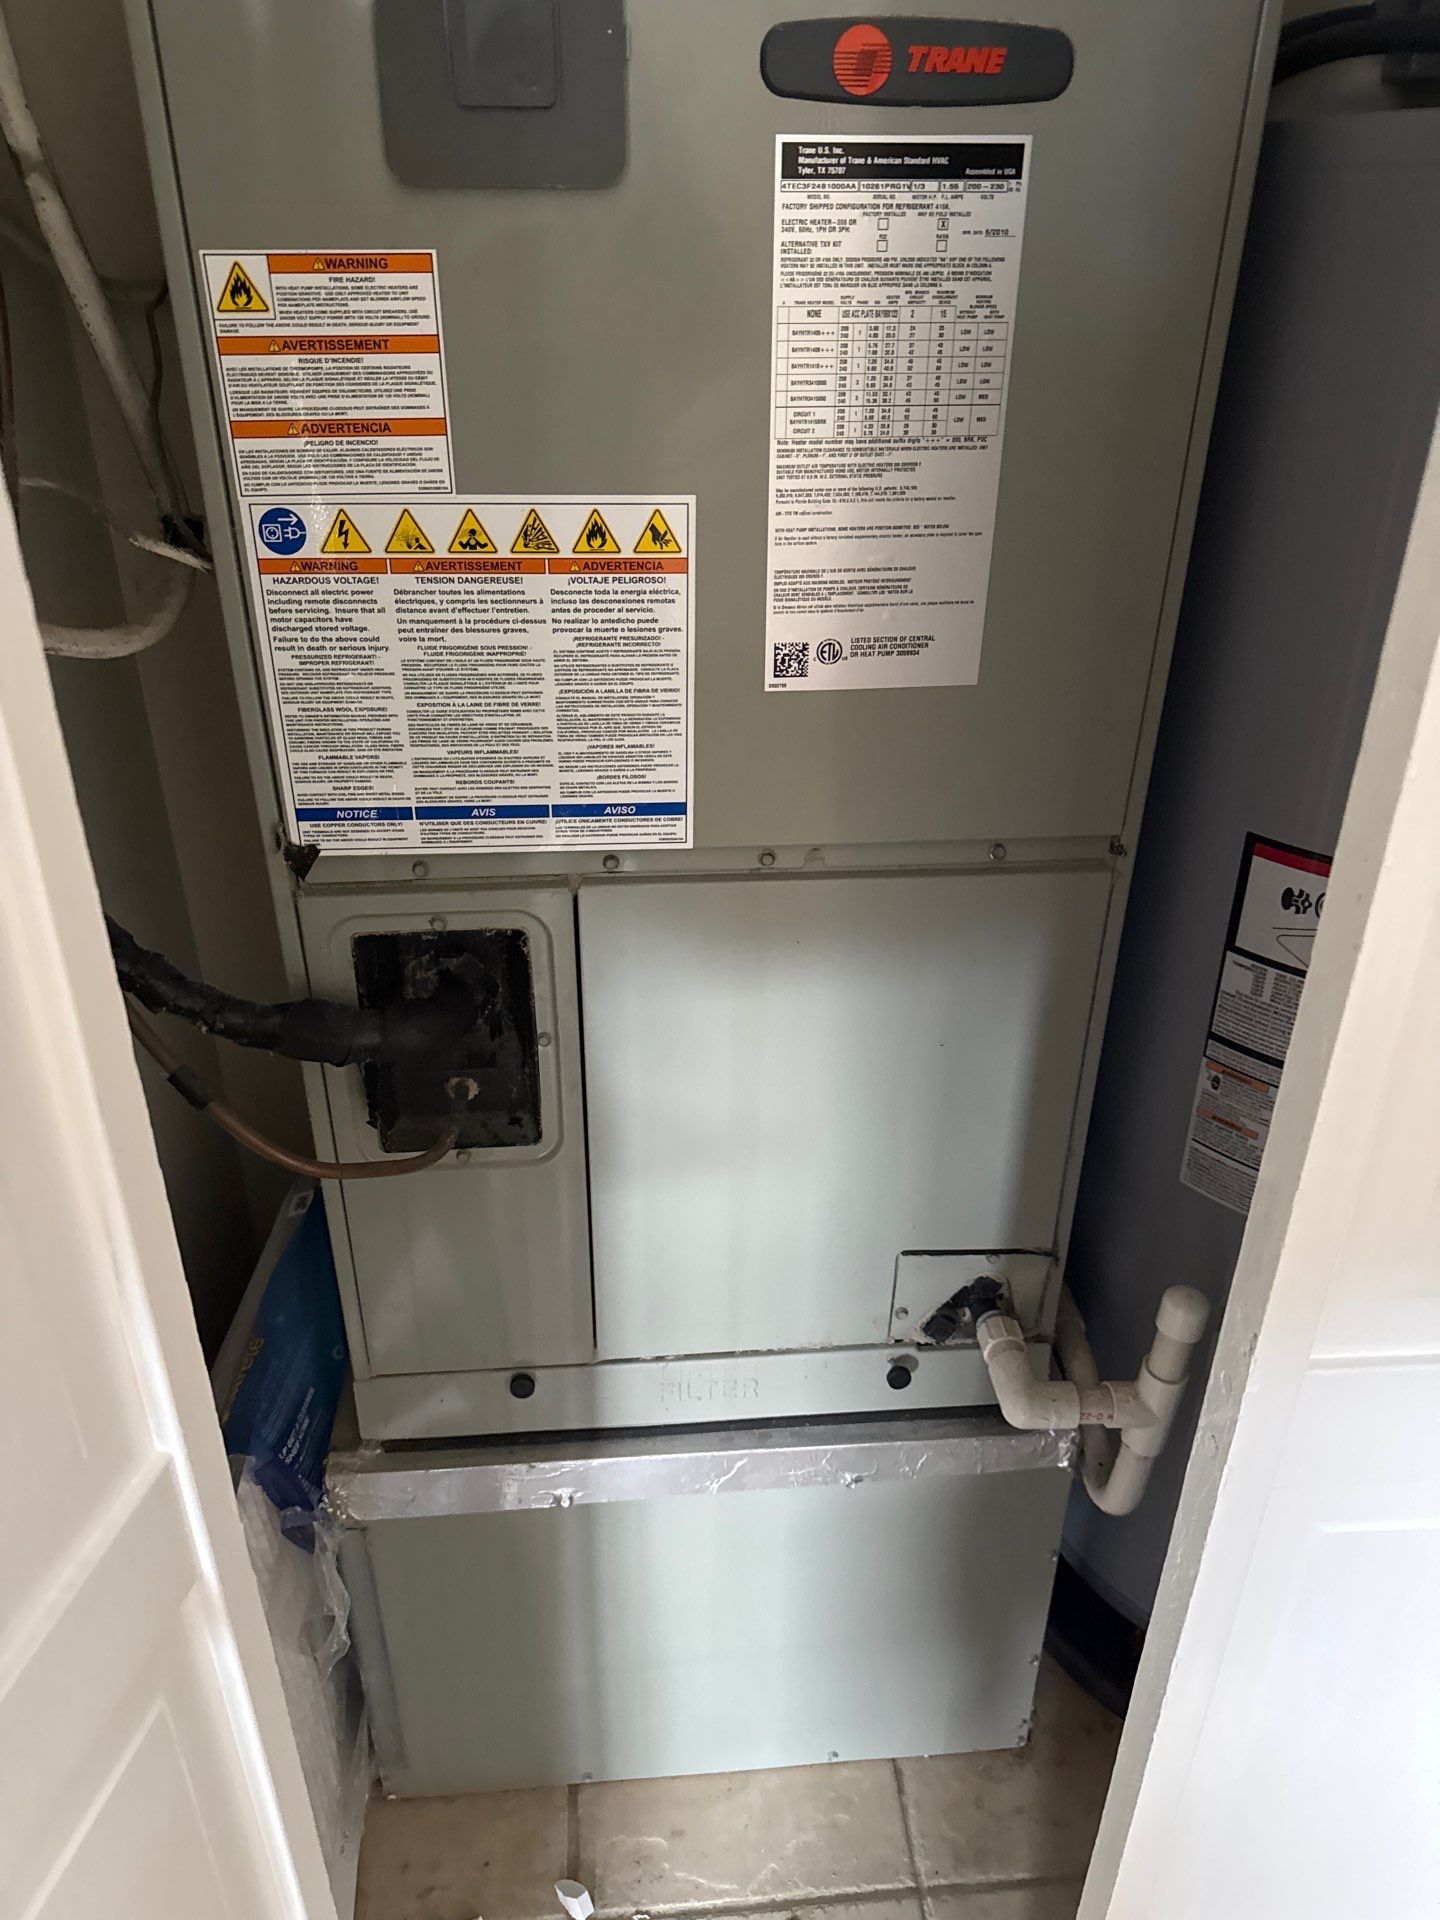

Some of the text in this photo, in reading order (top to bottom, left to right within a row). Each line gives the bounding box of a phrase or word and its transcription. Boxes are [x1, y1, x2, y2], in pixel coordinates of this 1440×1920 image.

[908, 46, 1008, 74] TRANE
[798, 146, 816, 154] Trane
[818, 146, 831, 154] U.S.
[848, 156, 866, 164] Trane
[798, 166, 816, 176] Tyler,
[324, 258, 388, 270] WARNING
[807, 310, 822, 318] NONE
[282, 339, 389, 351] AVERTISSEMENT
[302, 422, 392, 434] ADVERTENCIA
[300, 561, 358, 571] WARNING
[424, 561, 523, 571] AVERTISSEMENT
[582, 561, 664, 571] ADVERTENCIA
[568, 577, 610, 586] ¡VOLTAJE
[272, 625, 313, 633] discharged
[820, 642, 839, 661] ETL
[336, 810, 379, 819] NOTICE
[471, 808, 496, 817] AVIS
[604, 806, 636, 814] AVISO
[660, 1378, 758, 1402] FILTER
